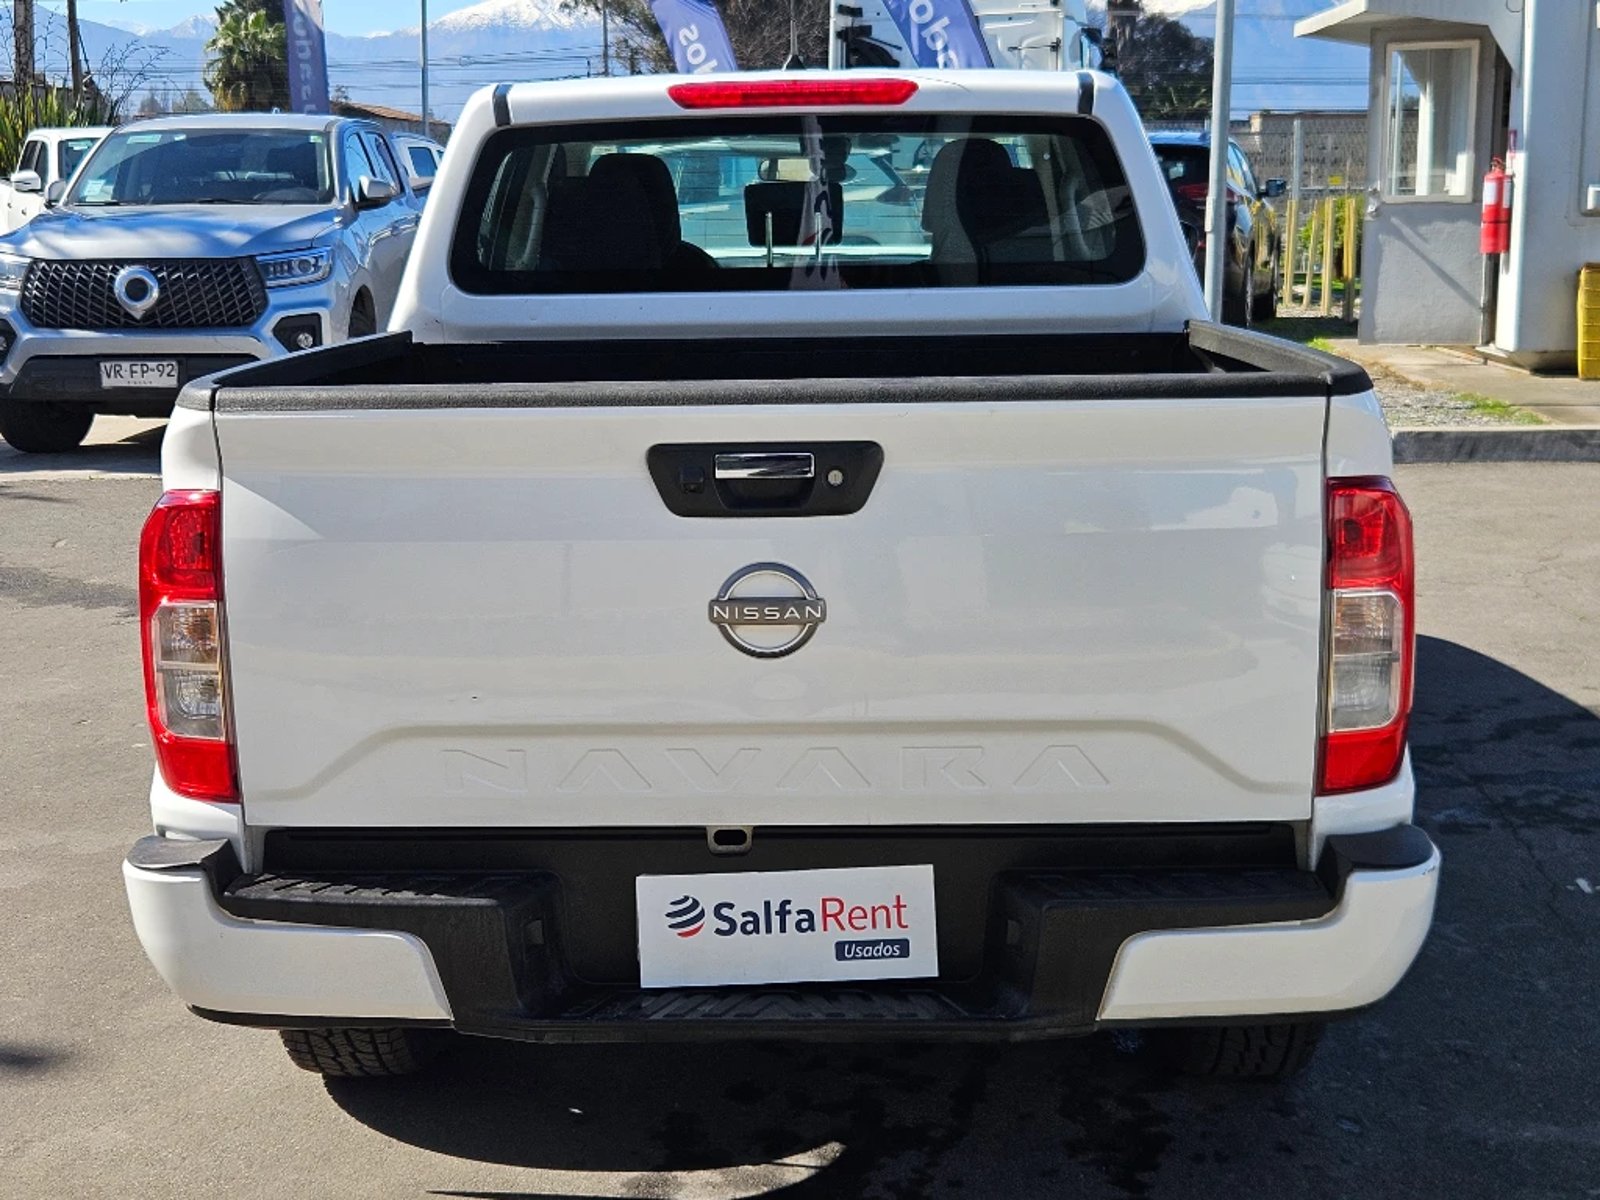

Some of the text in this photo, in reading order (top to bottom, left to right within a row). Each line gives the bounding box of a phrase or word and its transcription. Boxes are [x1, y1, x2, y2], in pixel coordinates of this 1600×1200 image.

[713, 605, 821, 620] NISSAN
[440, 745, 1111, 793] NAVARA
[843, 941, 901, 959] Usados
